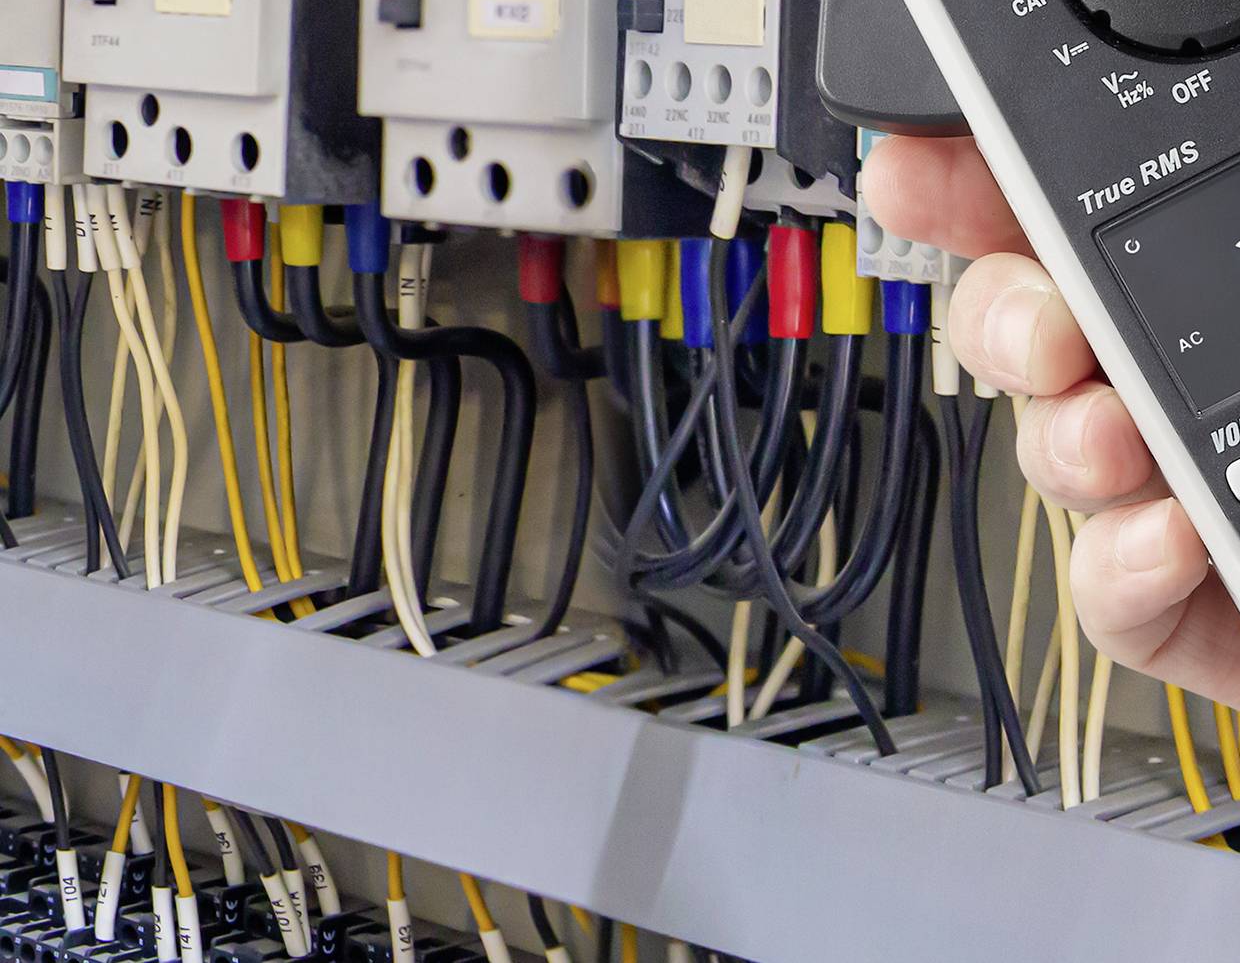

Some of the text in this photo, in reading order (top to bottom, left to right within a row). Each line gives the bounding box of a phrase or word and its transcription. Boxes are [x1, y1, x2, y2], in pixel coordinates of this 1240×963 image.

[1117, 80, 1154, 108] Hz%
[1172, 69, 1213, 105] OFF
[1077, 140, 1200, 214] True RMS
[400, 278, 415, 296] 1N
[1178, 331, 1204, 353] AC
[62, 876, 79, 902] 104
[180, 927, 193, 950] 141
